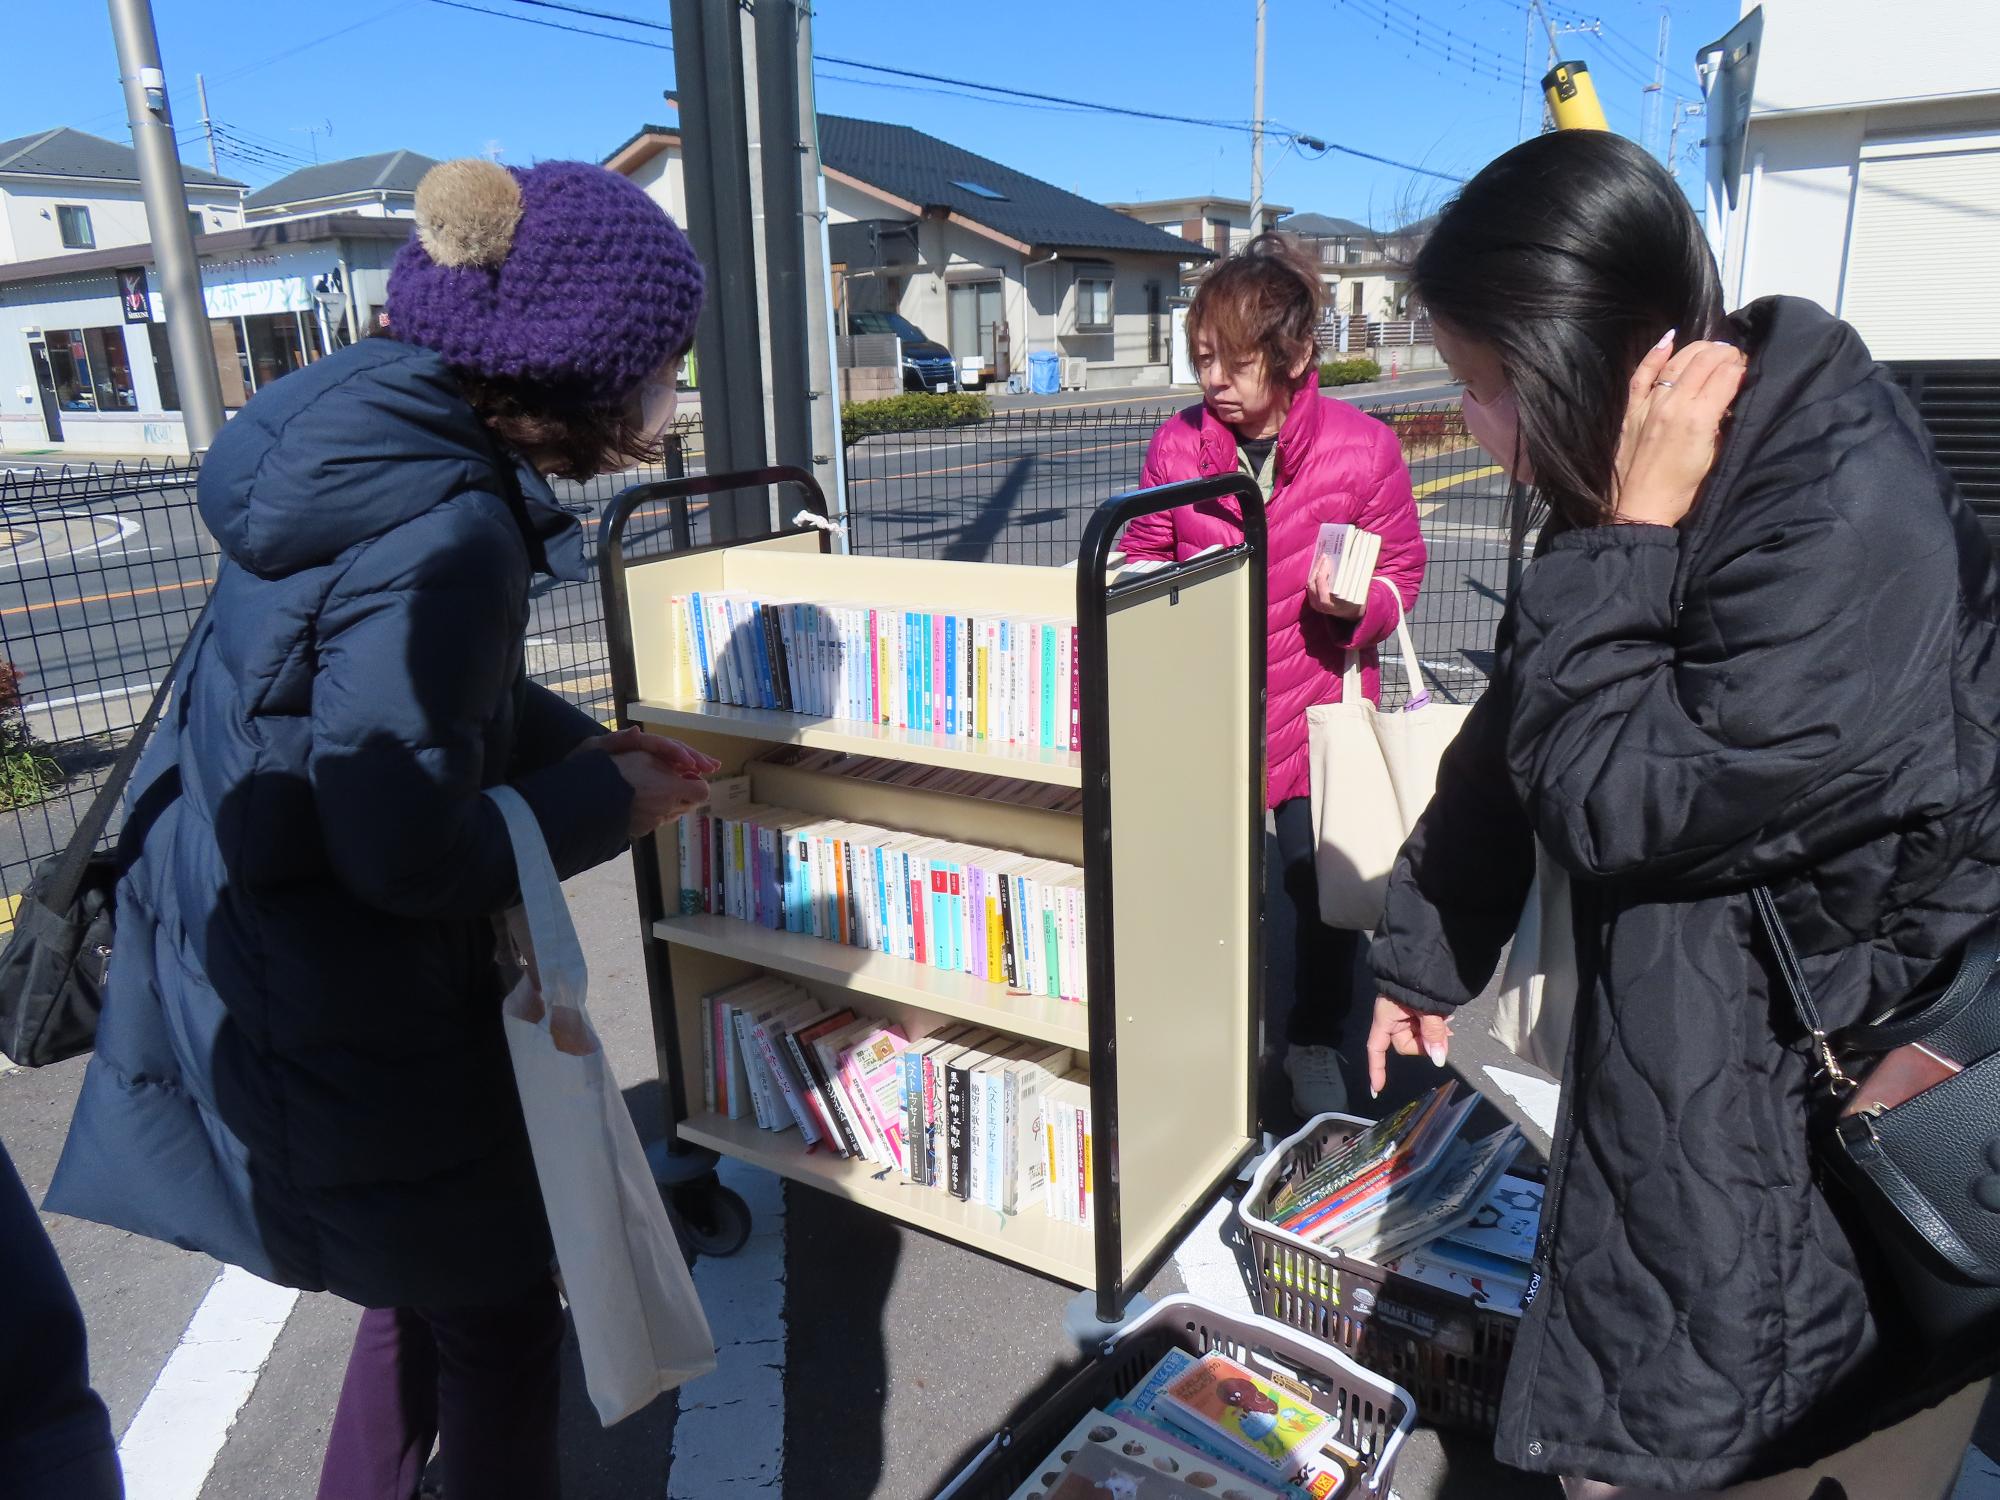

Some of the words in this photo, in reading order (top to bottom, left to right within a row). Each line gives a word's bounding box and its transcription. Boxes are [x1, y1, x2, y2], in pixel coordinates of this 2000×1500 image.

[906, 1061, 920, 1127] ベスト・エッセイ
[1525, 1272, 1541, 1304] ROXY
